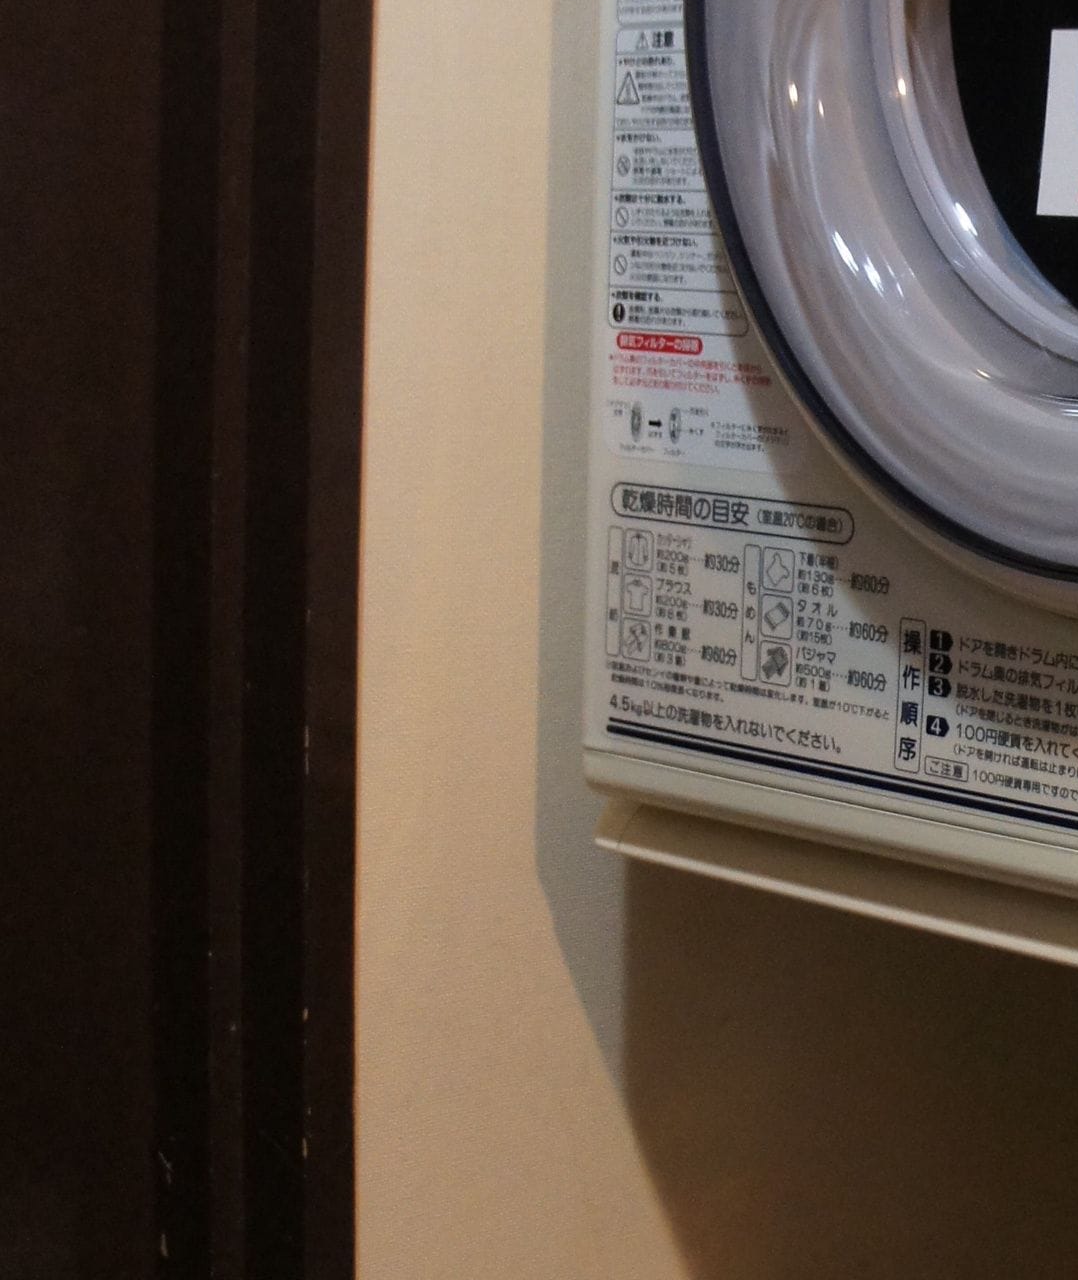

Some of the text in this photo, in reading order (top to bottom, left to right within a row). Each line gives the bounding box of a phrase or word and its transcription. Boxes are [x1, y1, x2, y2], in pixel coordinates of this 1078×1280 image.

[622, 489, 750, 526] 乾燥時間の目安
[745, 581, 757, 644] もめん
[797, 599, 838, 618] タオル
[795, 647, 837, 665] パジャマ
[897, 629, 923, 762] 操作順序
[929, 759, 964, 780] ご注意
